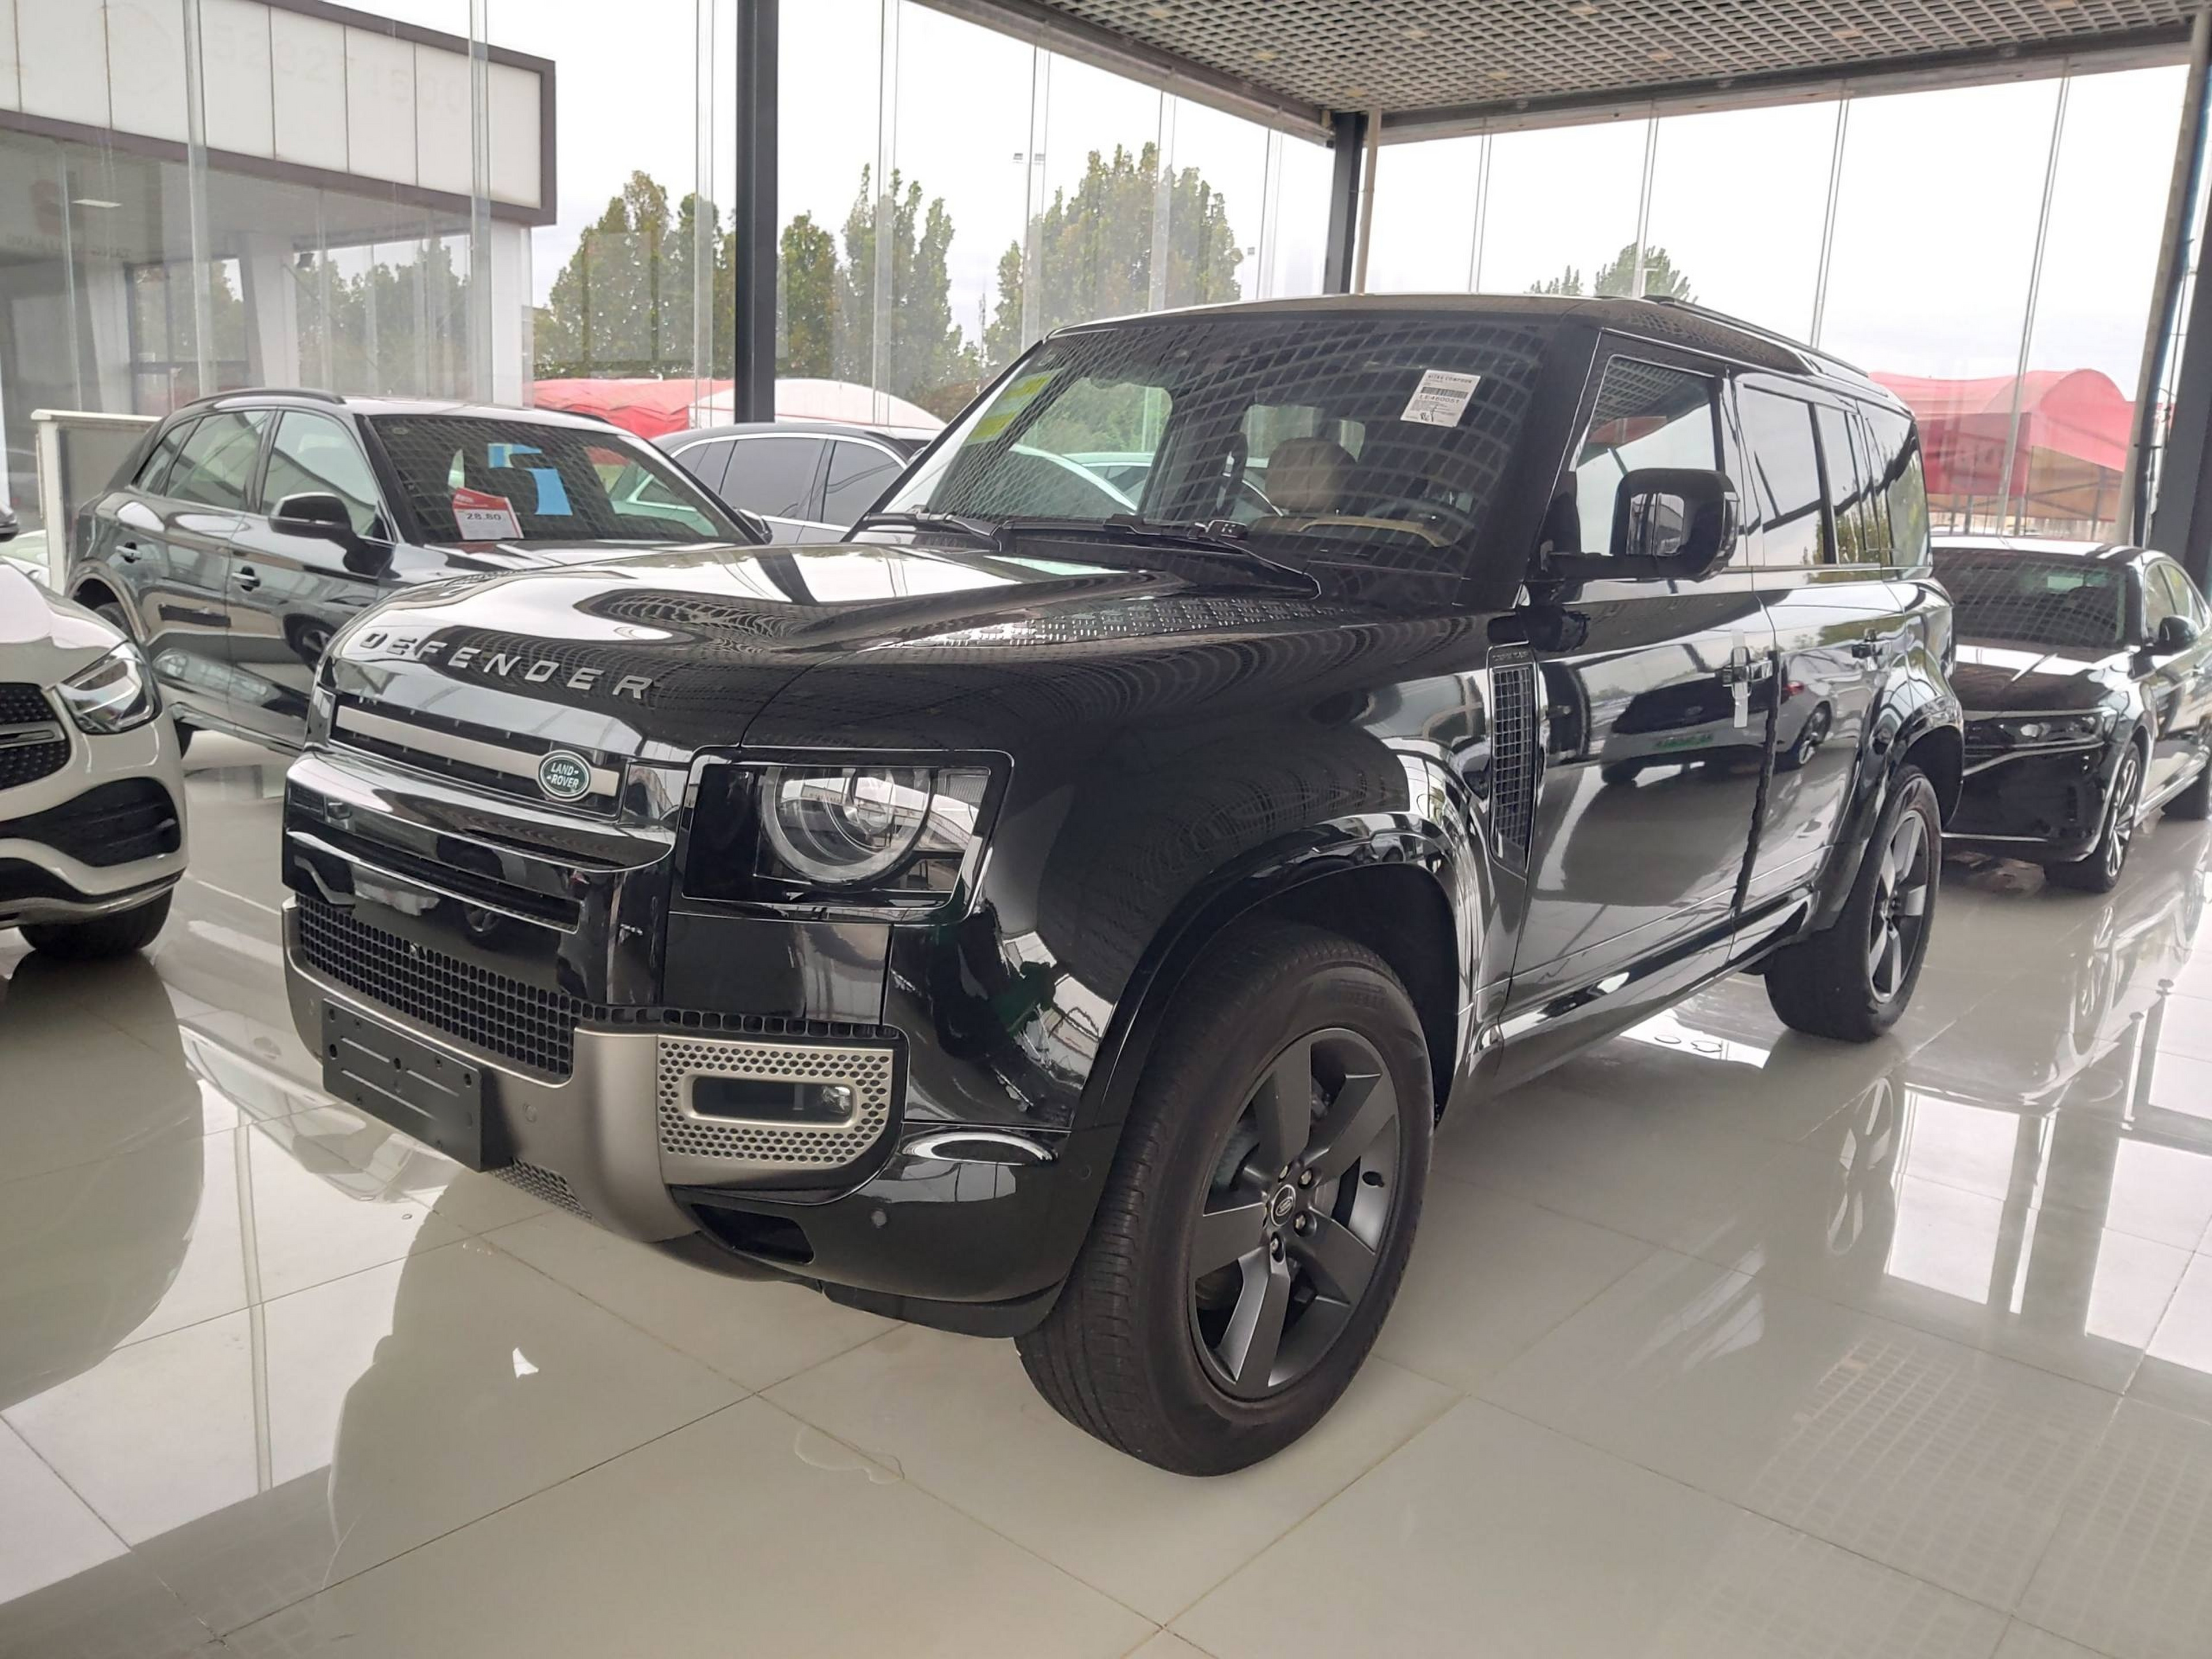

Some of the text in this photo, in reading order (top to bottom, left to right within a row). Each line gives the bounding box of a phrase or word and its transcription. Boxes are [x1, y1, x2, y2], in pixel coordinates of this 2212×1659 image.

[359, 632, 653, 699] DEFENDER
[550, 762, 574, 777] LAND
[550, 774, 579, 789] ROVER
